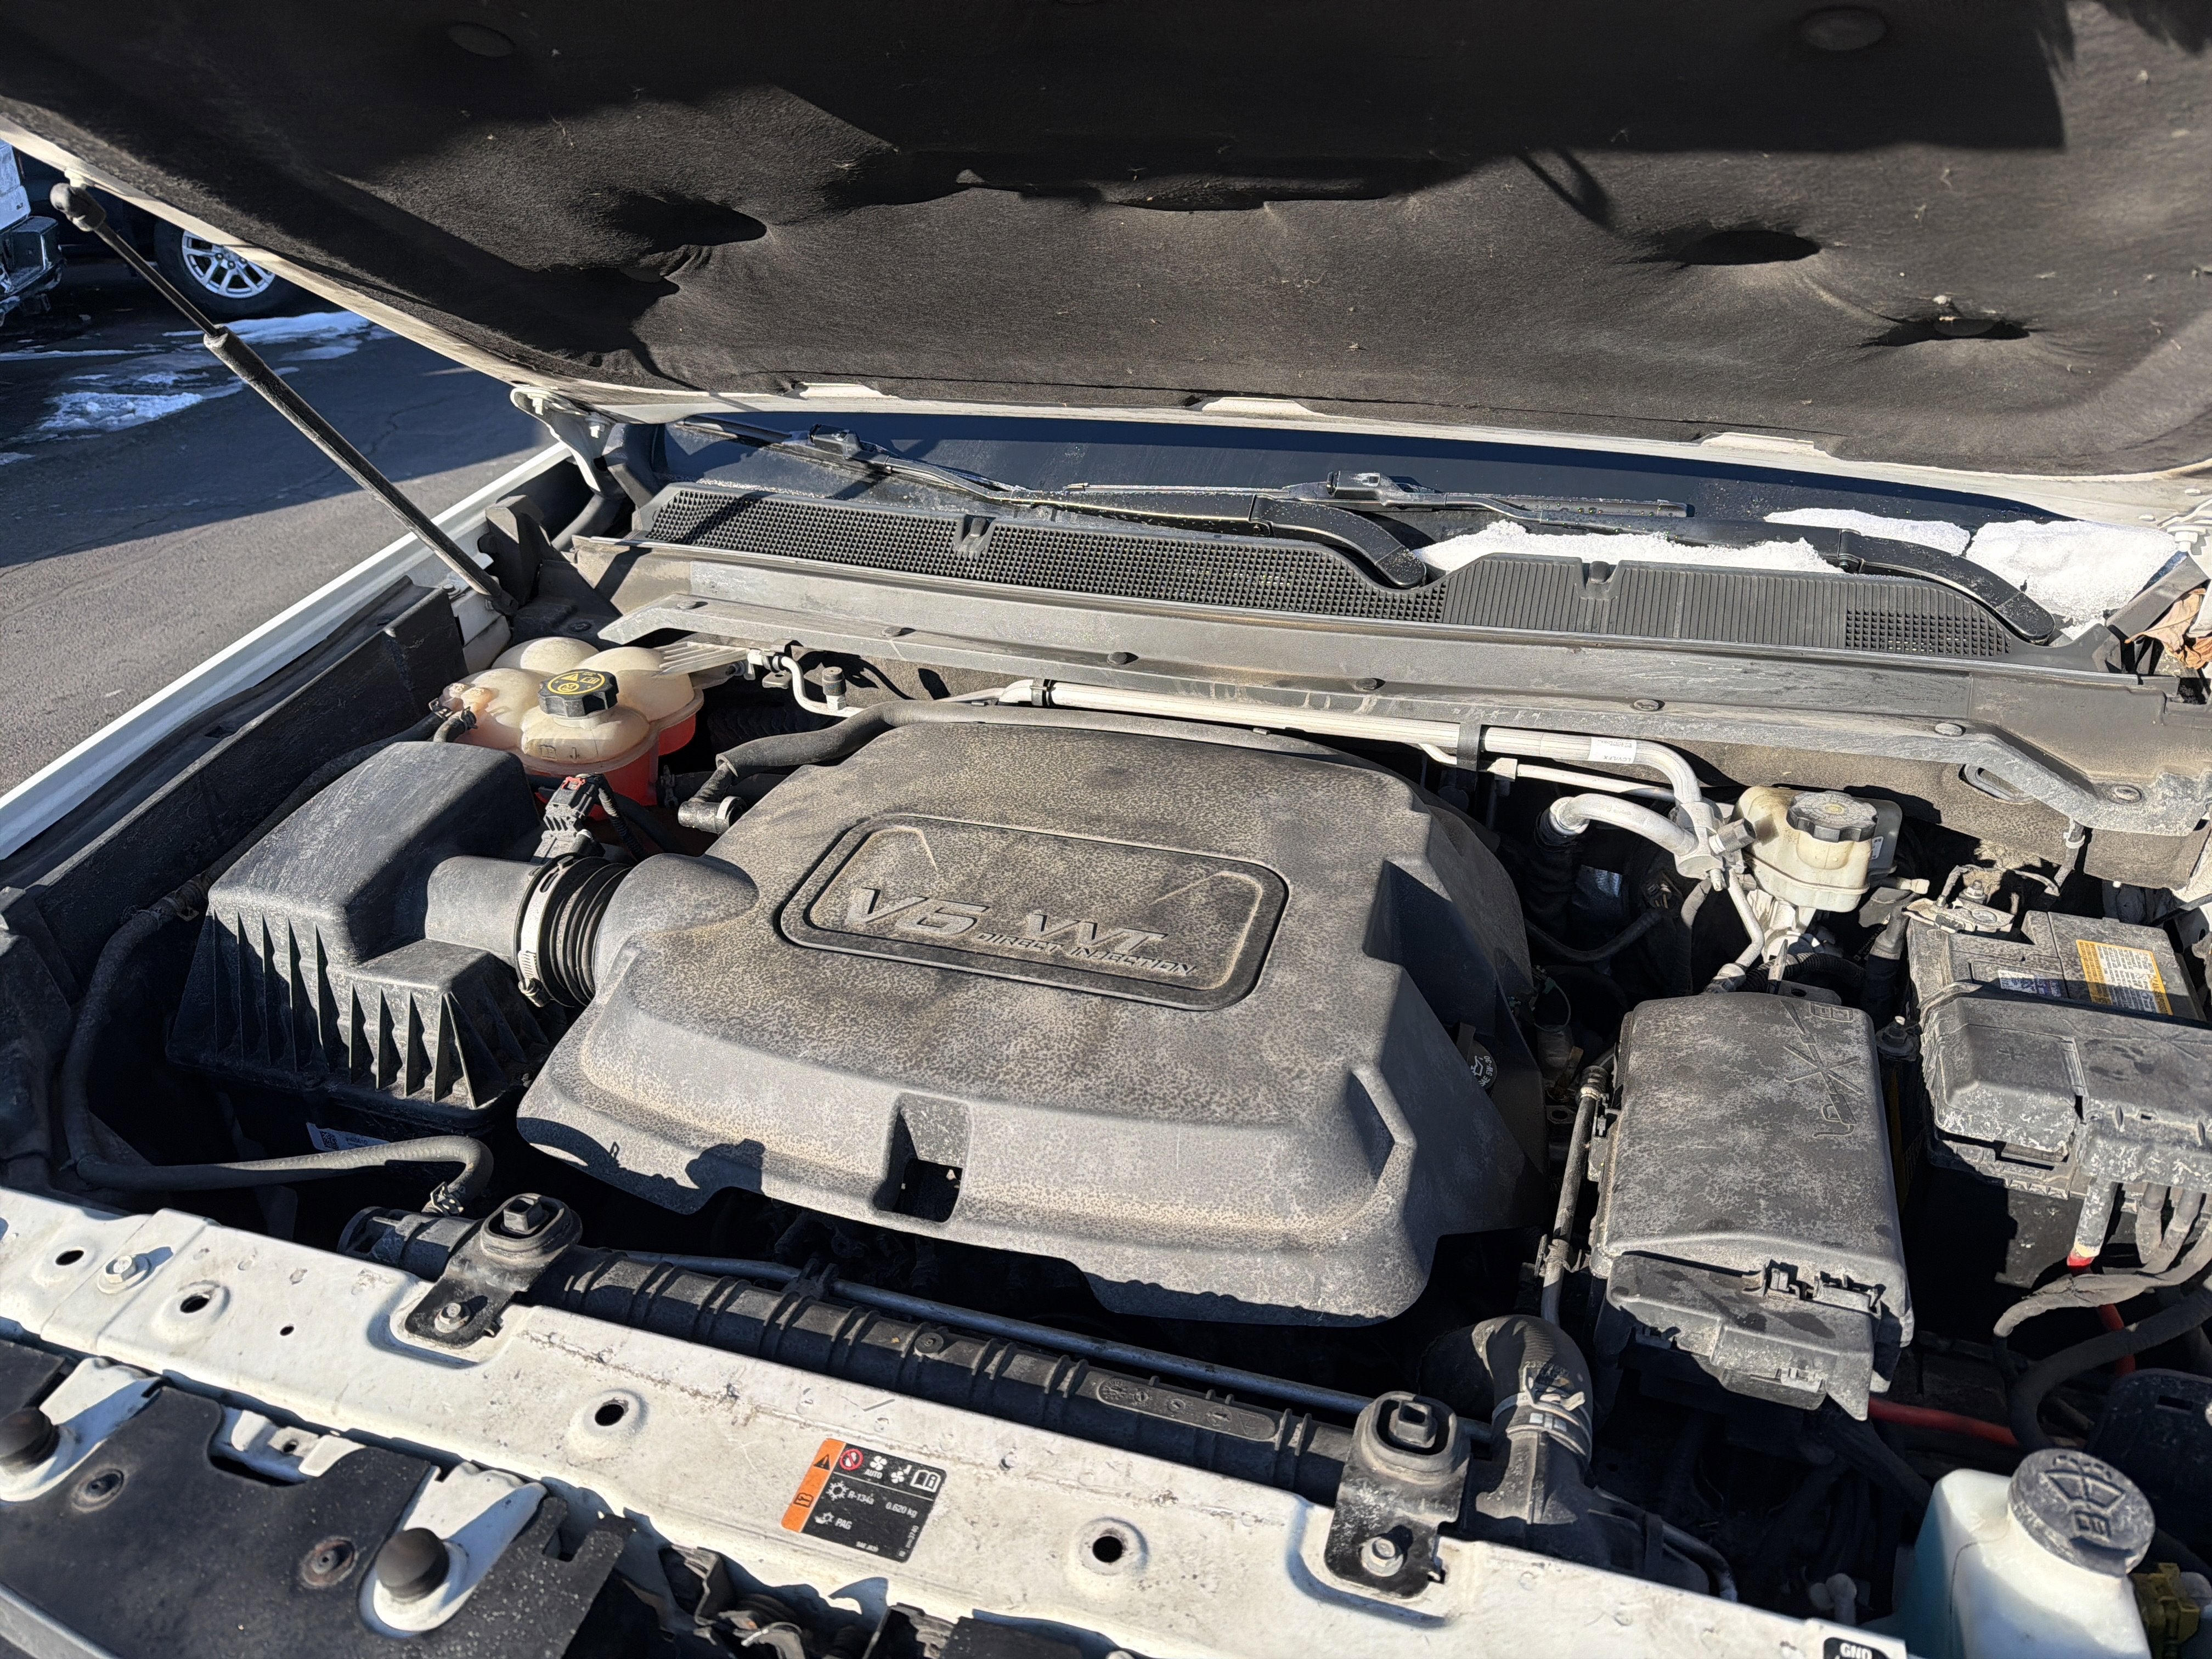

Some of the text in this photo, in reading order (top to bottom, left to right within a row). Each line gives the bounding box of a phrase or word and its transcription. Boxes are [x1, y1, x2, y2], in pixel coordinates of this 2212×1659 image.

[845, 887, 1169, 952] V6 VVT
[977, 933, 1197, 976] DIRECT INJECTION
[1479, 1056, 1493, 1087] SAE 5W-30
[865, 1470, 883, 1479] AUTO
[848, 1491, 918, 1518] R-134a 0.620 kg
[835, 1518, 852, 1530] PAG
